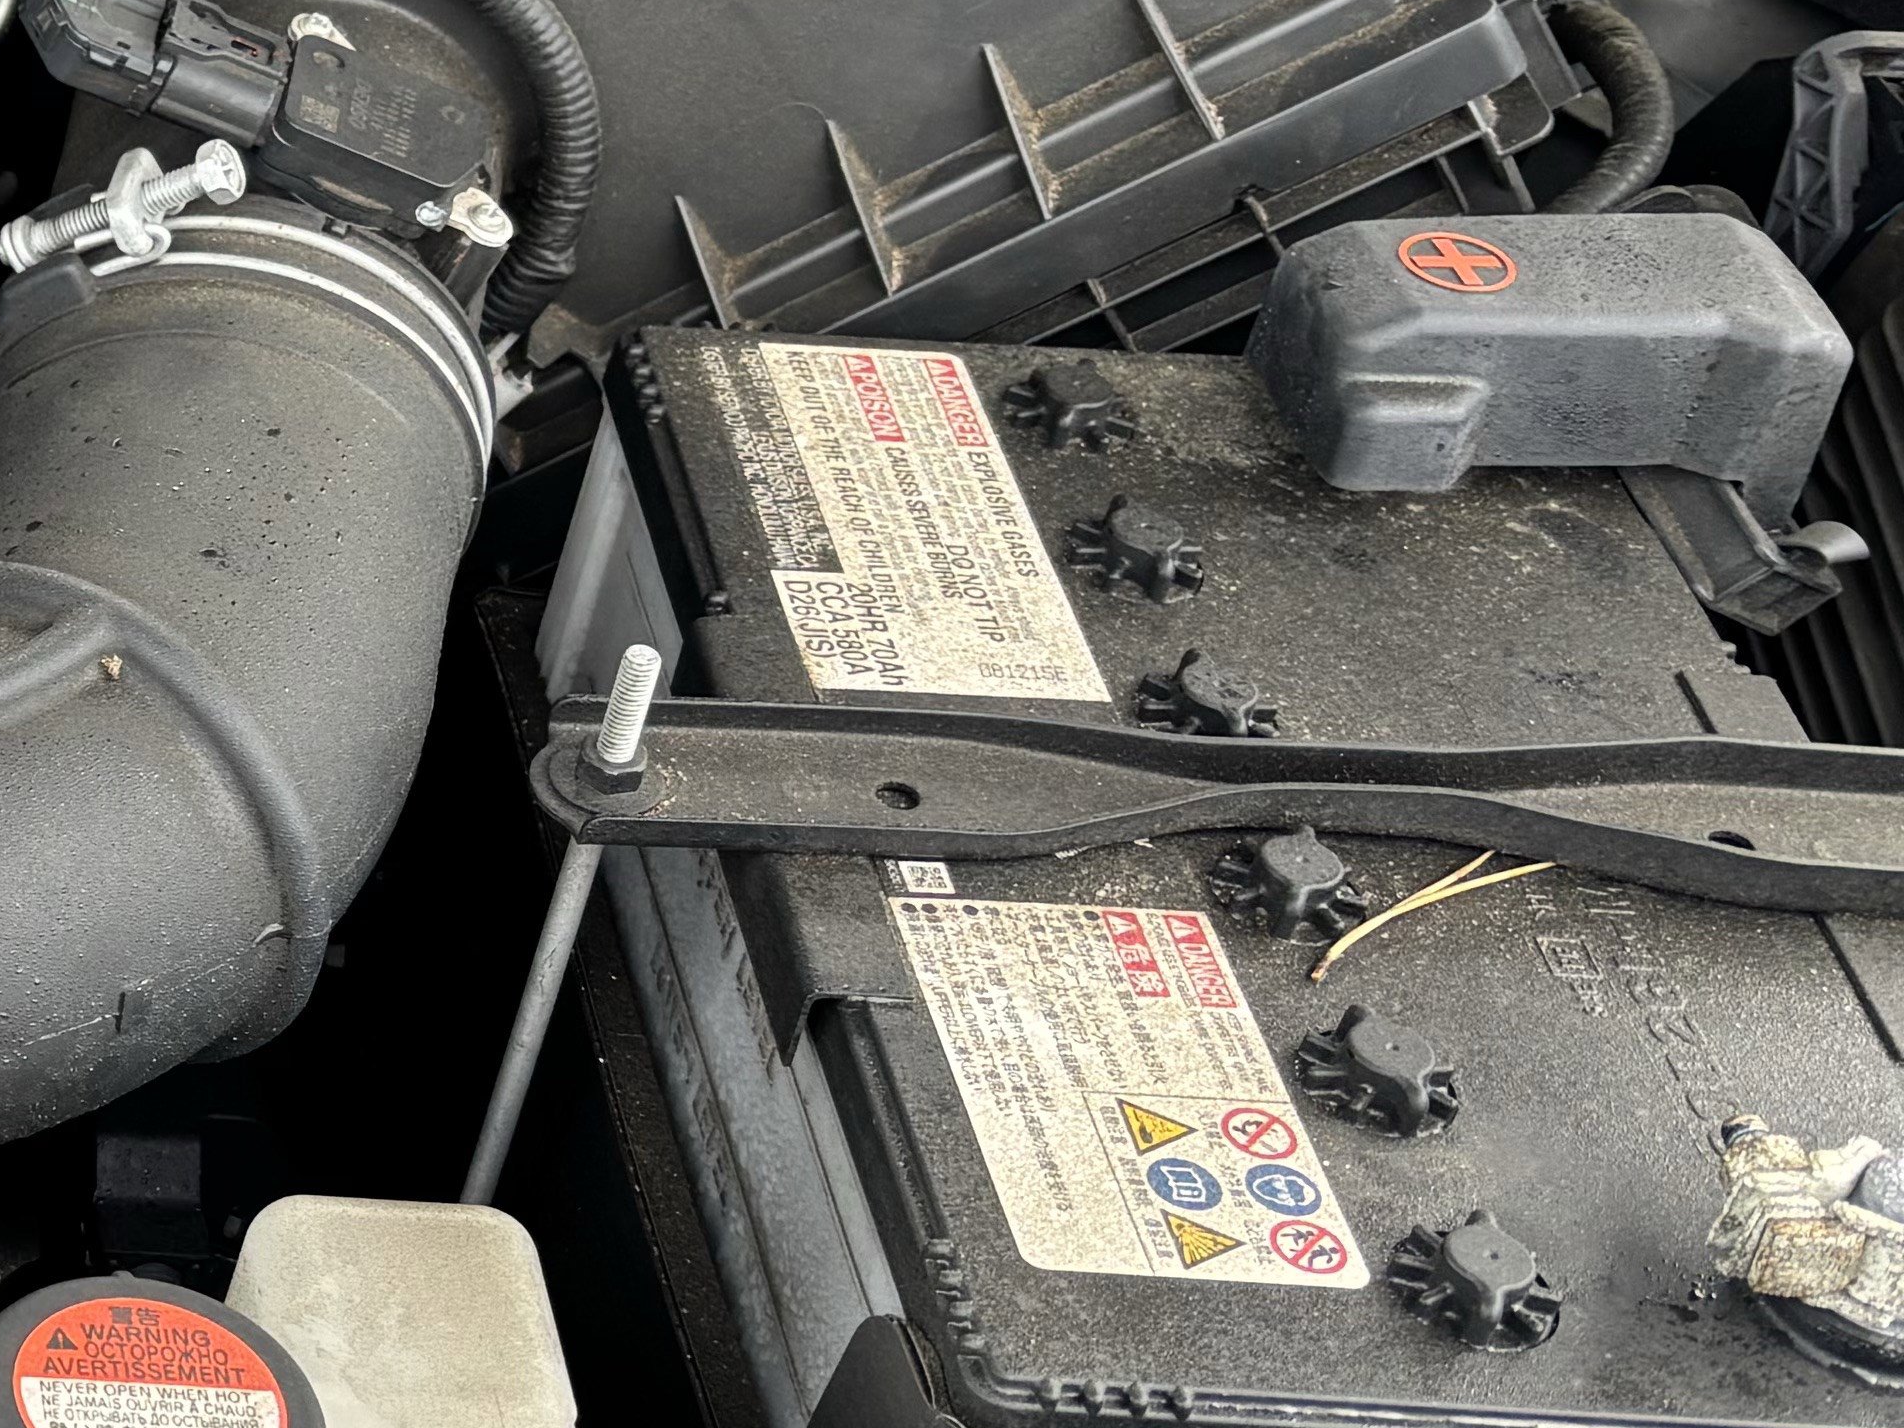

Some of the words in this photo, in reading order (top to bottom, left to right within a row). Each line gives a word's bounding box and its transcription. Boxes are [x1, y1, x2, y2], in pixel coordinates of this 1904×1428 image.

[785, 350, 814, 382] KEEP
[799, 385, 826, 412] OUT
[811, 415, 835, 434] OF
[818, 436, 846, 462] THE
[830, 467, 864, 512] REACH
[852, 372, 901, 437] POISON
[885, 446, 922, 496] CAUSES
[905, 499, 943, 548] SEVERE
[928, 551, 962, 599] BURNS
[932, 375, 986, 446] DANGER
[967, 451, 1018, 526] EXPLOSIVE
[1002, 530, 1039, 577] GASES
[850, 516, 874, 536] OF
[947, 544, 974, 569] DO
[857, 539, 905, 613] CHILDREN
[958, 574, 991, 610] NOT
[815, 581, 856, 624] CCA
[845, 582, 889, 633] 20HR
[783, 580, 832, 659] D26(JIS)
[975, 615, 1005, 642] TIP
[832, 628, 874, 675] 580A
[866, 637, 910, 686] 70Ah
[1116, 941, 1167, 994] 危険
[1176, 941, 1236, 1006] DANGER
[81, 1323, 211, 1347] WARNING
[84, 1342, 228, 1366] ОСТОРОЖНО
[43, 1357, 245, 1385] AVERTISSEMENT
[40, 1380, 98, 1395] NEVER
[104, 1383, 151, 1398] OPEN
[156, 1387, 209, 1403] WHEN
[41, 1394, 60, 1407] NE
[67, 1396, 122, 1411] JAMAIS
[126, 1398, 184, 1414] OUVRIR
[43, 1406, 59, 1421] НЕ
[151, 1413, 170, 1427] ДО
